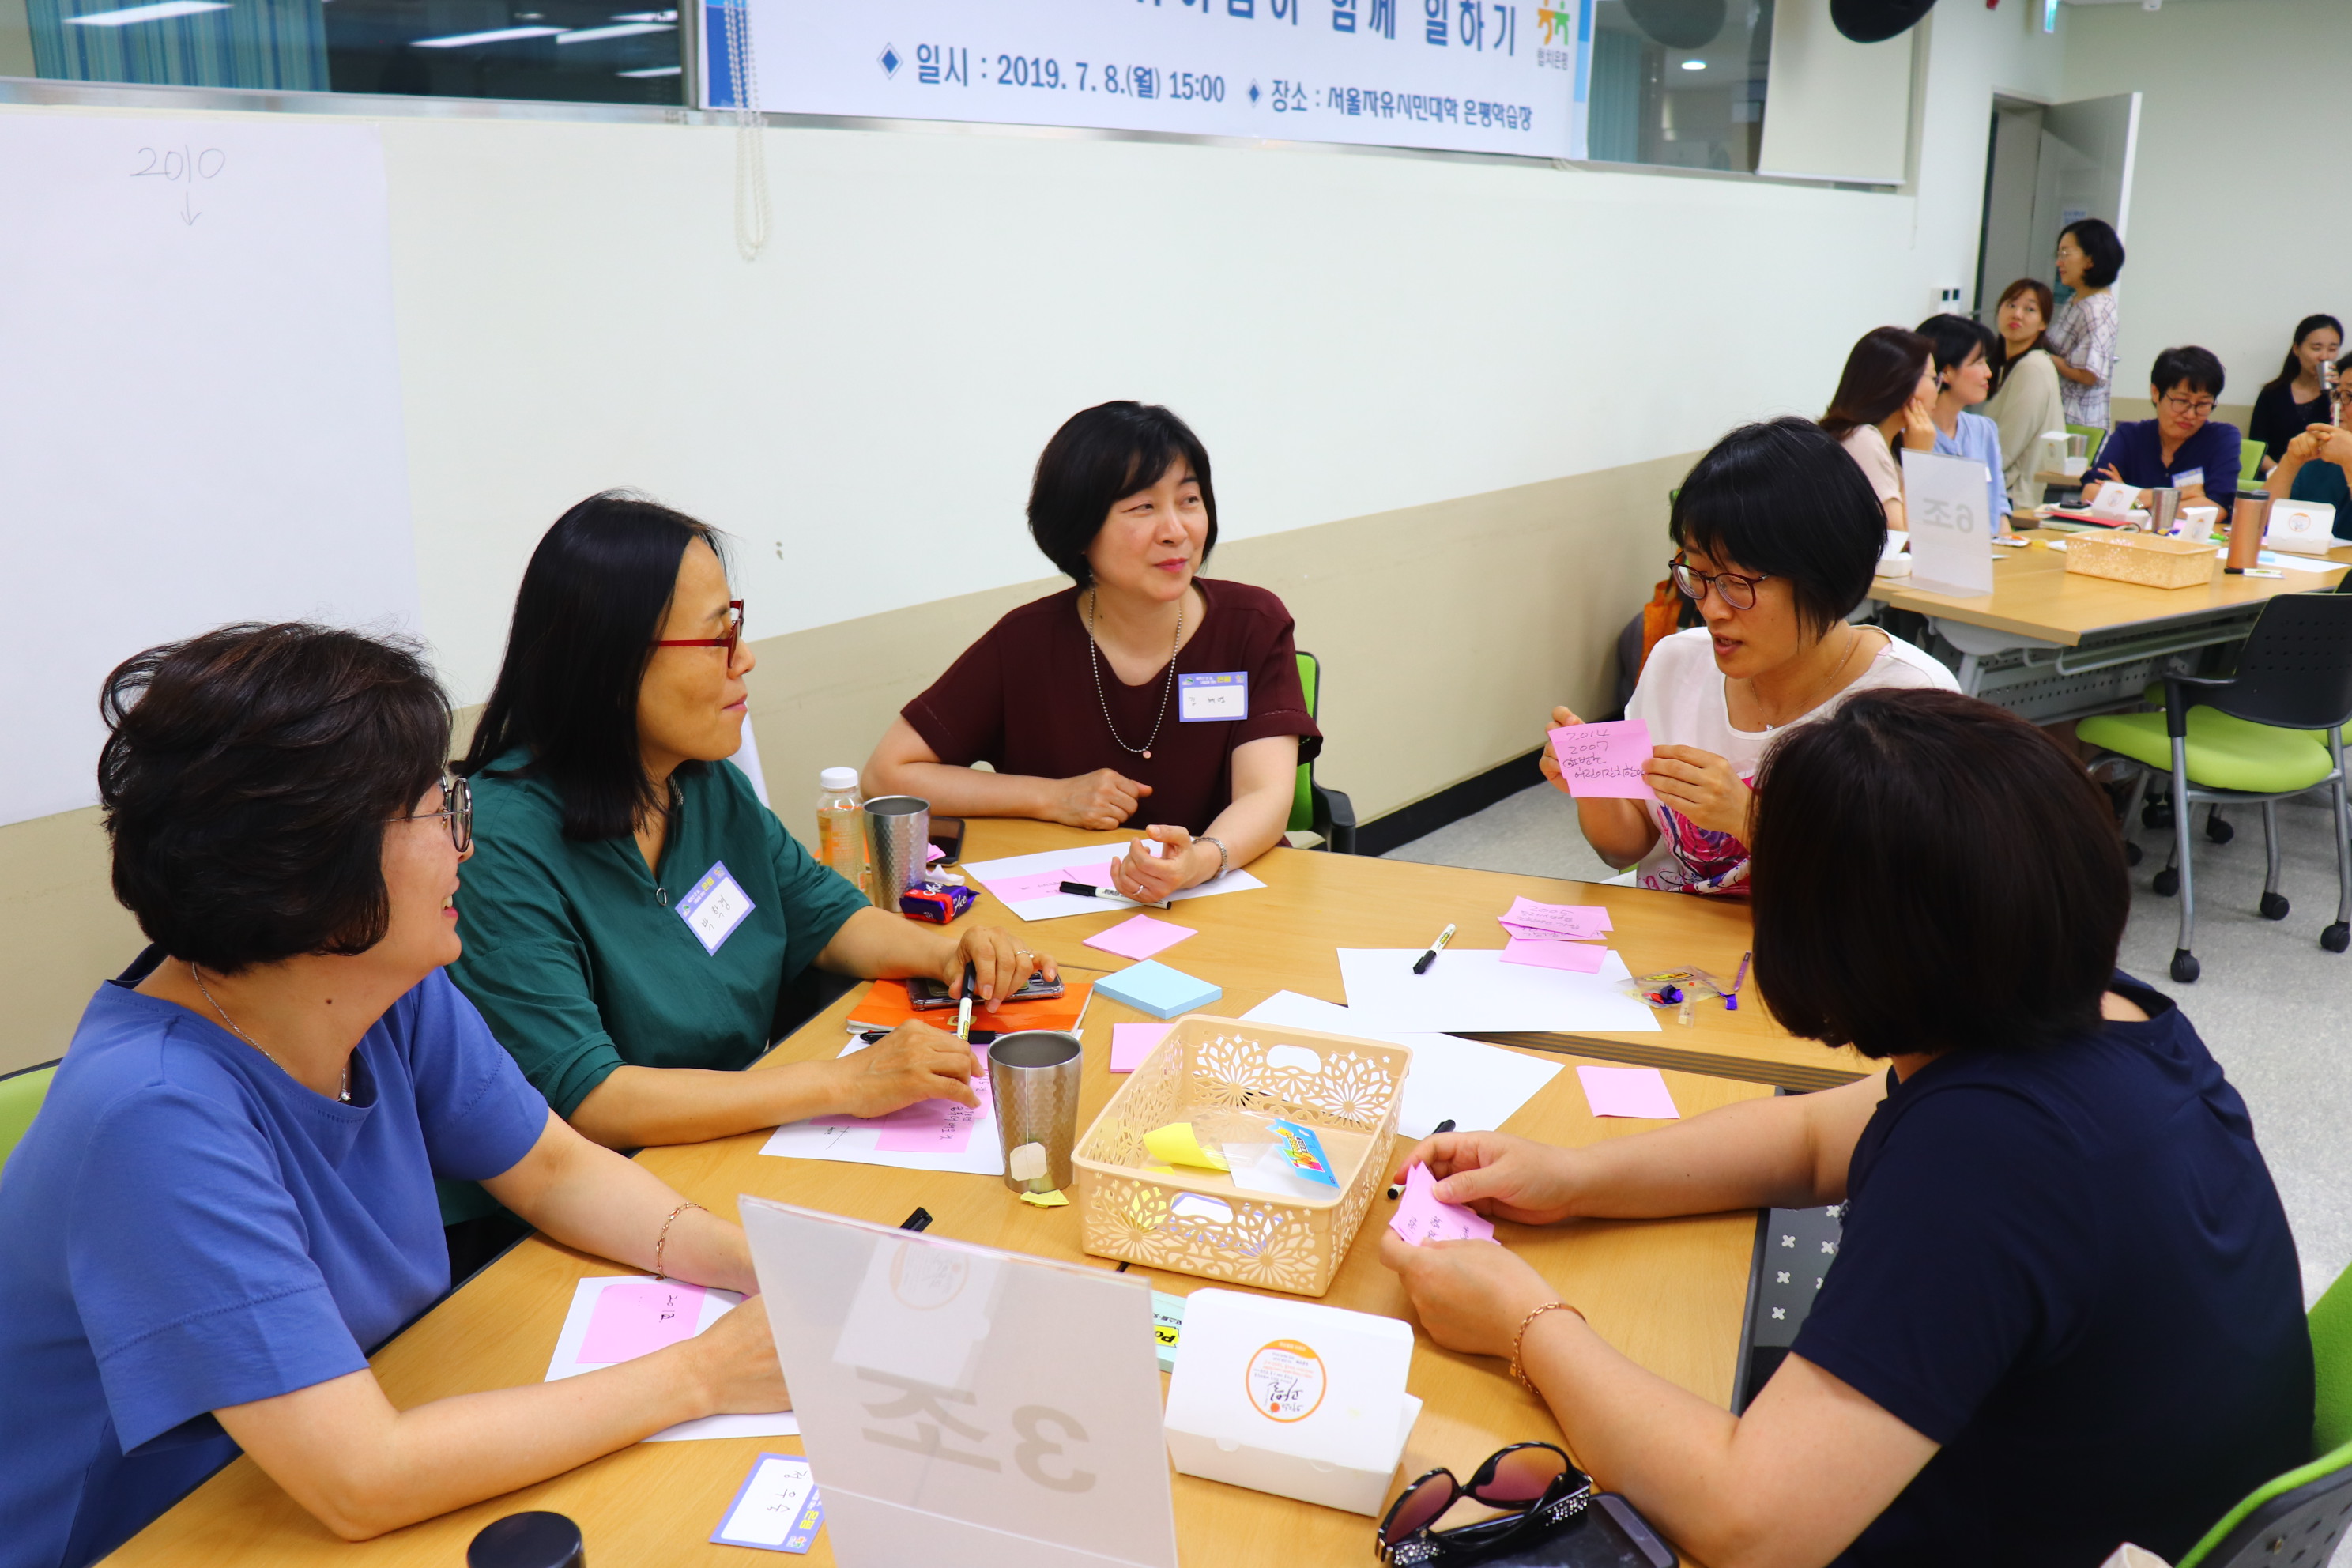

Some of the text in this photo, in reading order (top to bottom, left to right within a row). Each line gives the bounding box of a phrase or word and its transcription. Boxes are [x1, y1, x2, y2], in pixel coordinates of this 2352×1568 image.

[1425, 0, 1515, 56] 일하기
[916, 44, 968, 87] 일시
[997, 55, 1067, 90] 2019.
[1075, 62, 1097, 91] 7.
[1104, 64, 1160, 100] 8.(월)
[1169, 71, 1225, 103] 15:00
[1271, 80, 1308, 112] 장소
[1328, 86, 1458, 124] 서울자유시민대학
[1464, 100, 1533, 131] 은평학습장
[129, 144, 225, 183] 2010
[1566, 729, 1610, 741] 2014
[1567, 741, 1609, 755] 2007
[1528, 905, 1575, 917] 2005
